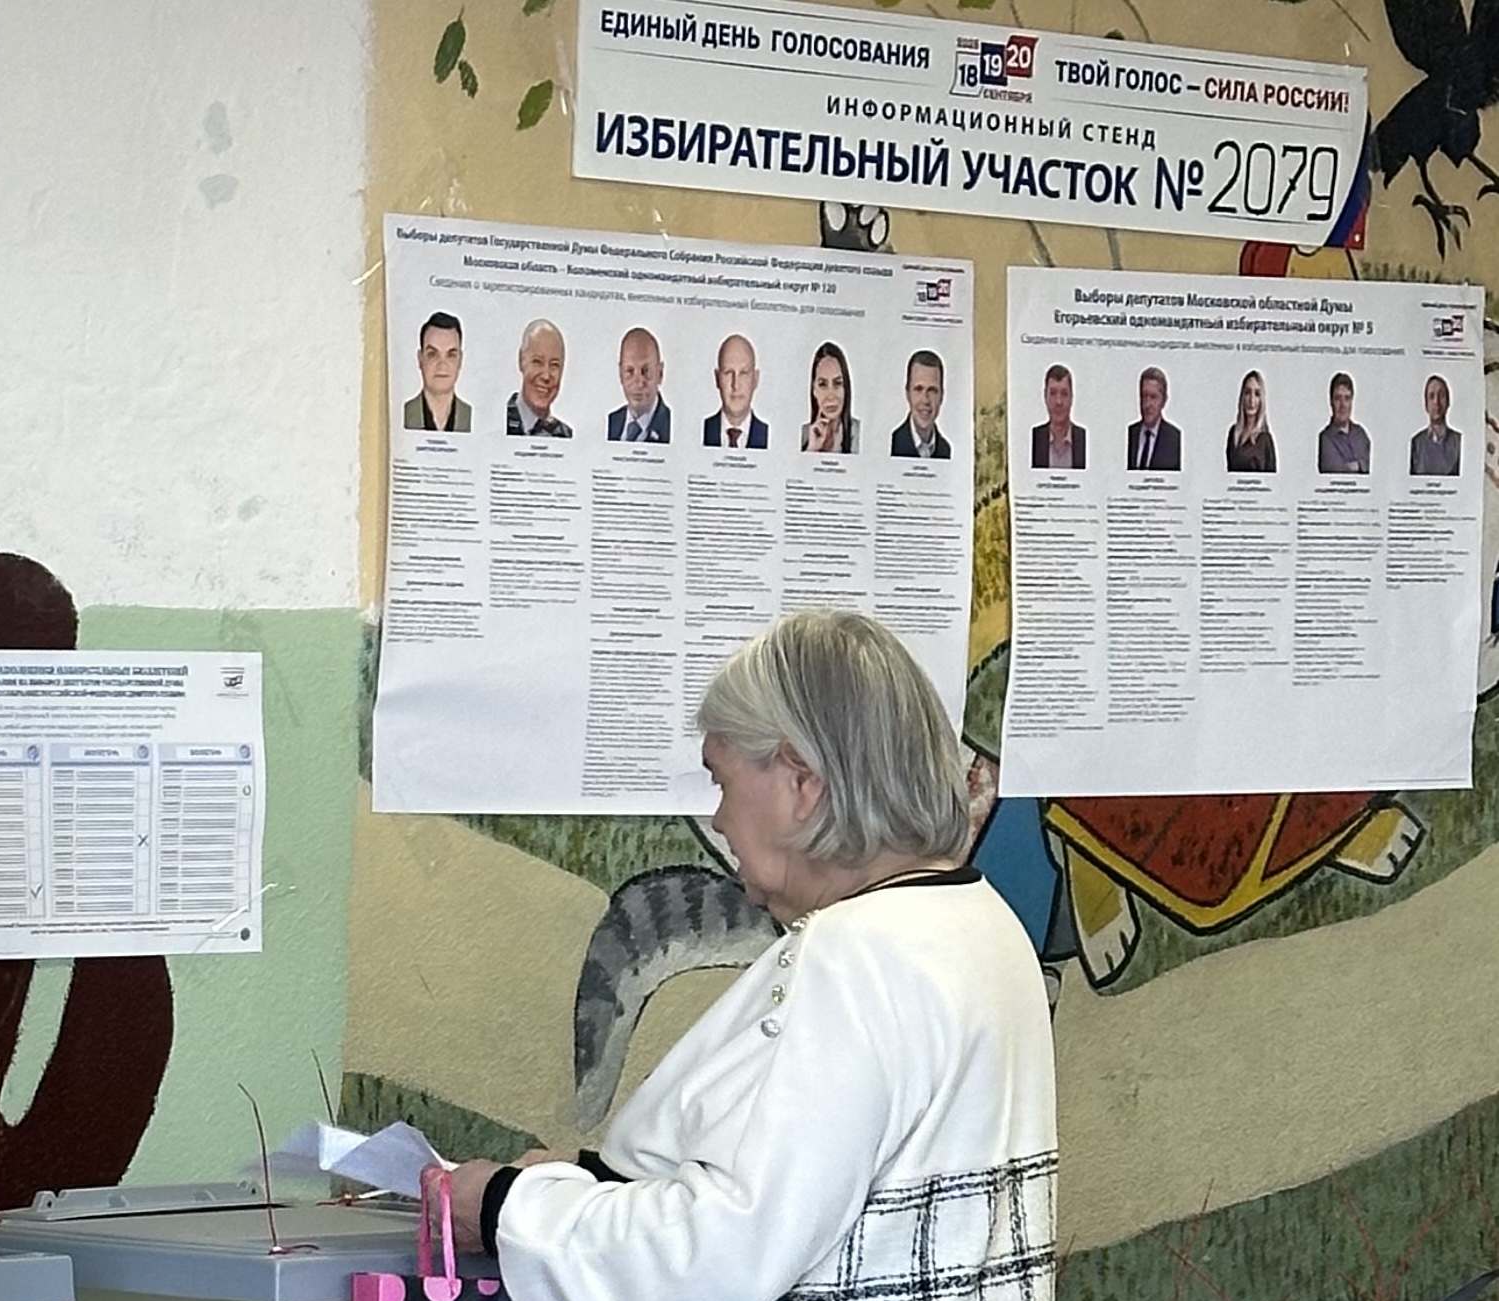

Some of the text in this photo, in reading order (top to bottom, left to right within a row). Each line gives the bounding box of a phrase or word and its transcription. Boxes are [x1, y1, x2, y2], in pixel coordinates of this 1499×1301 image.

[600, 10, 696, 43] ЕДИНЫЙ
[702, 22, 760, 50] ДЕНЬ
[771, 30, 930, 69] ГОЛОСОВАНИЯ
[983, 54, 1002, 77] 19
[1007, 44, 1031, 69] 20
[959, 64, 978, 87] 18
[1055, 59, 1110, 88] ТВОЙ
[1114, 67, 1182, 95] ГОЛОС
[1204, 77, 1257, 104] СИЛА
[1264, 85, 1349, 113] РОССИИ!
[826, 95, 1156, 151] ИНФОРМАЦИОННЫЙ СТЕНД
[596, 111, 1338, 220] ИЗБИРАТЕЛЬНЫЙ УЧАСТОК № 2079
[397, 227, 437, 242] Выборы
[439, 233, 488, 246] депутатов
[1075, 288, 1353, 314] Выборы депутатов Московской областной Думы
[1054, 310, 1127, 327] Егорьевский
[1130, 314, 1223, 330] одномандатный
[1226, 316, 1316, 333] избирательный
[1318, 323, 1349, 337] округ
[1366, 321, 1373, 334] 5
